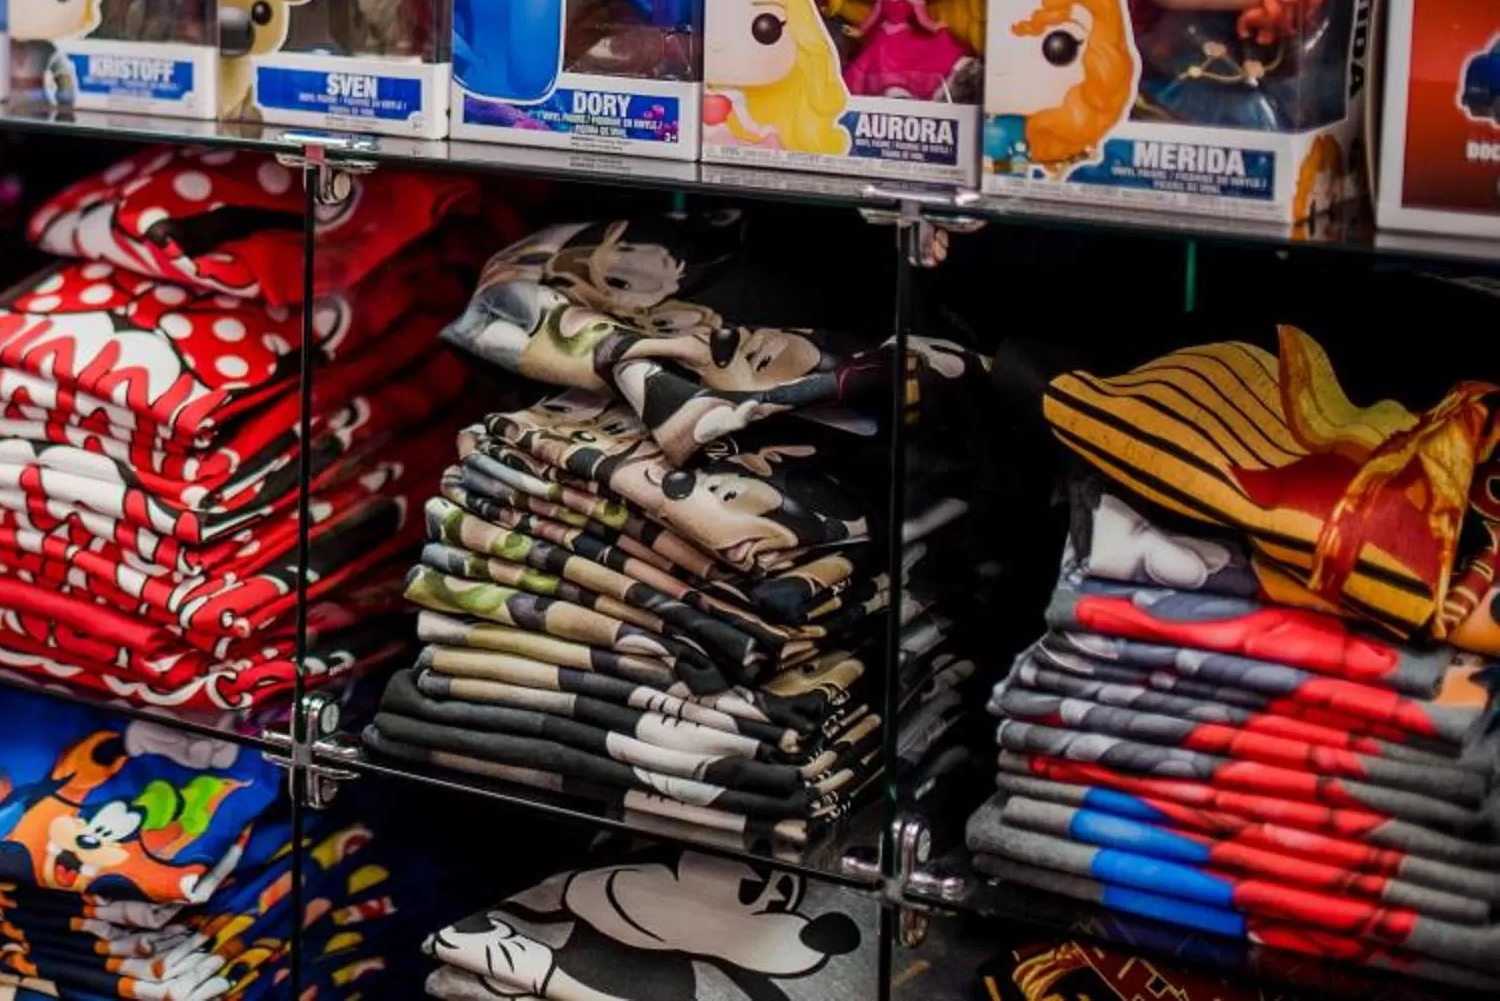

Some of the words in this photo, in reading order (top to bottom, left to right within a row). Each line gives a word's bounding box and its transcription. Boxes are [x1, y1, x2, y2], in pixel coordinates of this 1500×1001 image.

[89, 55, 175, 83] KRISTOFF
[327, 73, 378, 98] SVEN
[572, 91, 631, 117] DORY
[855, 113, 954, 146] AURORA
[1133, 142, 1246, 176] MERIDA
